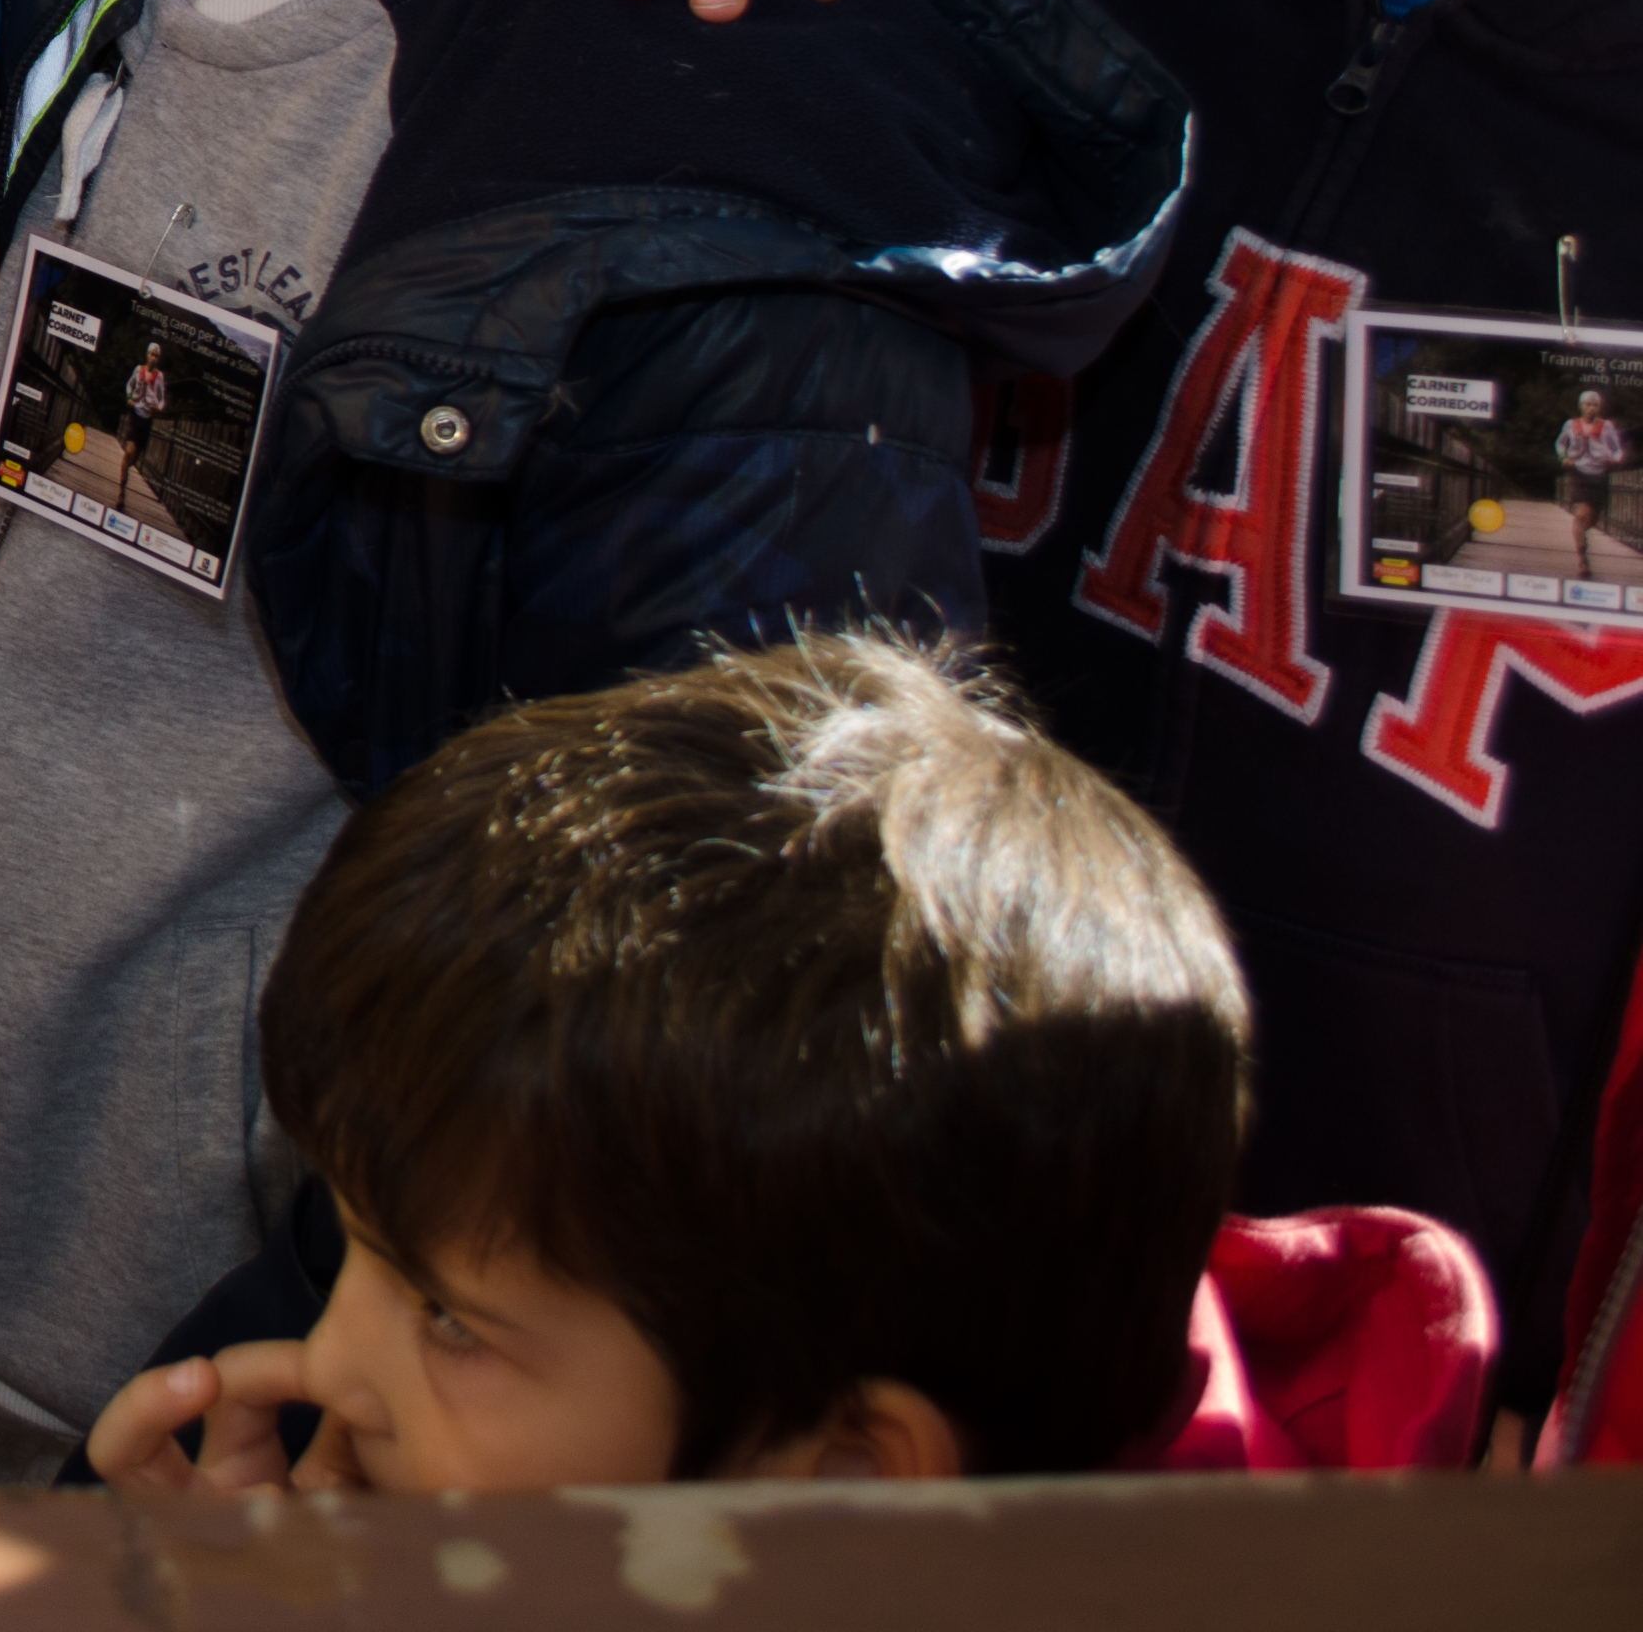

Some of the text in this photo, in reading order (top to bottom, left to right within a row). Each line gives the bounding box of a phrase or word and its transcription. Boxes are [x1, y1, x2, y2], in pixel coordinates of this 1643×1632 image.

[49, 302, 86, 327] CARNET
[46, 316, 97, 347] CORREDOR
[1541, 351, 1605, 372] Training
[1407, 378, 1468, 394] CARNET
[1407, 395, 1490, 413] CORREDOR
